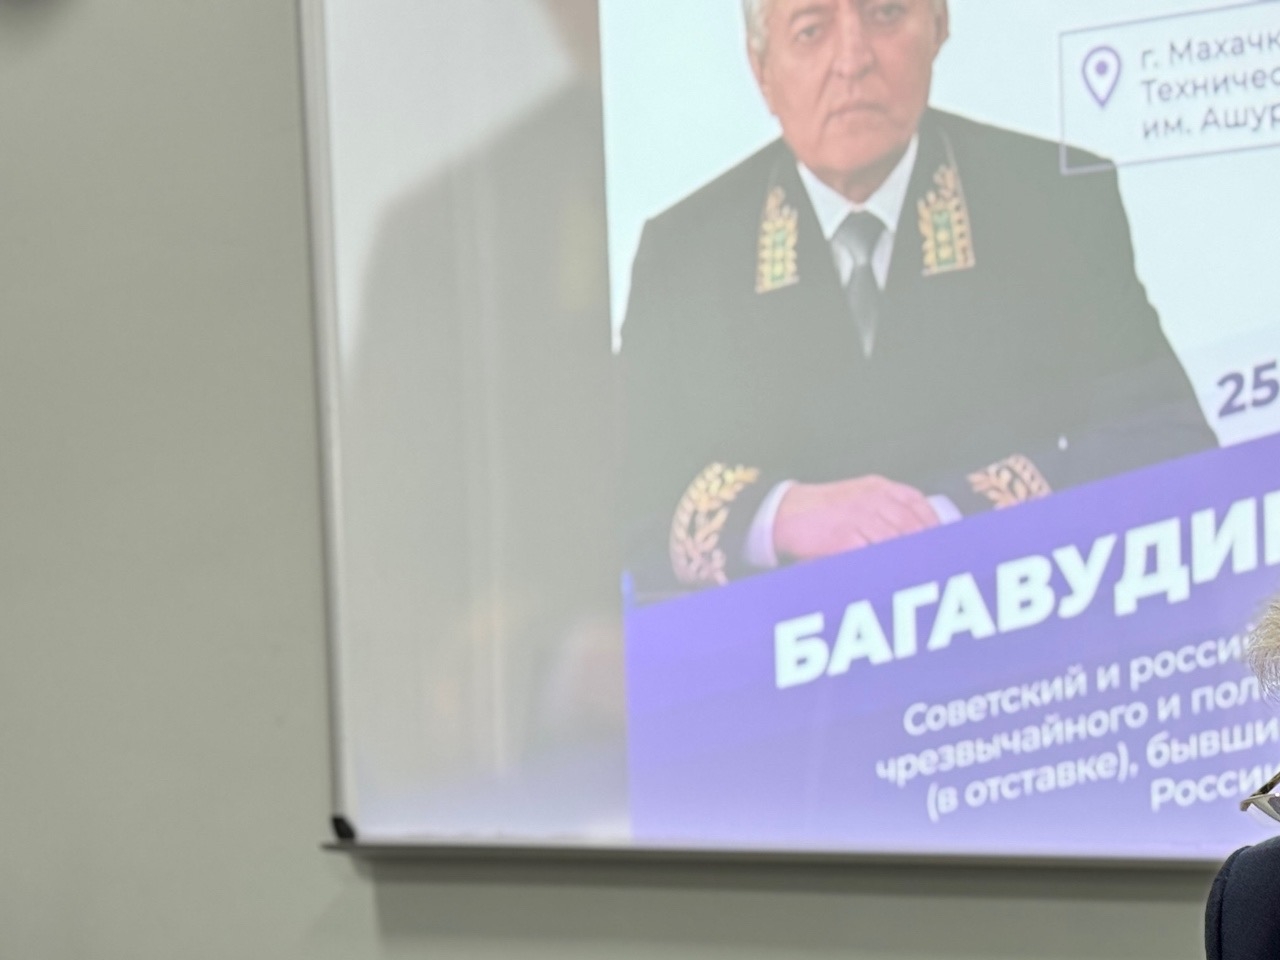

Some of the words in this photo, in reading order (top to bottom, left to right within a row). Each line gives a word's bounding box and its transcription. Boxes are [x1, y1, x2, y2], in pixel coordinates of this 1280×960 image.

[1141, 46, 1158, 69] г.
[1142, 113, 1191, 140] им.
[1217, 361, 1280, 417] 25
[903, 662, 1087, 737] Советский
[1097, 658, 1119, 686] и
[876, 700, 1147, 786] чрезвычайного
[1157, 694, 1180, 723] и
[926, 781, 958, 823] (в
[965, 742, 1138, 810] отставке),
[1146, 716, 1280, 768] бывши
